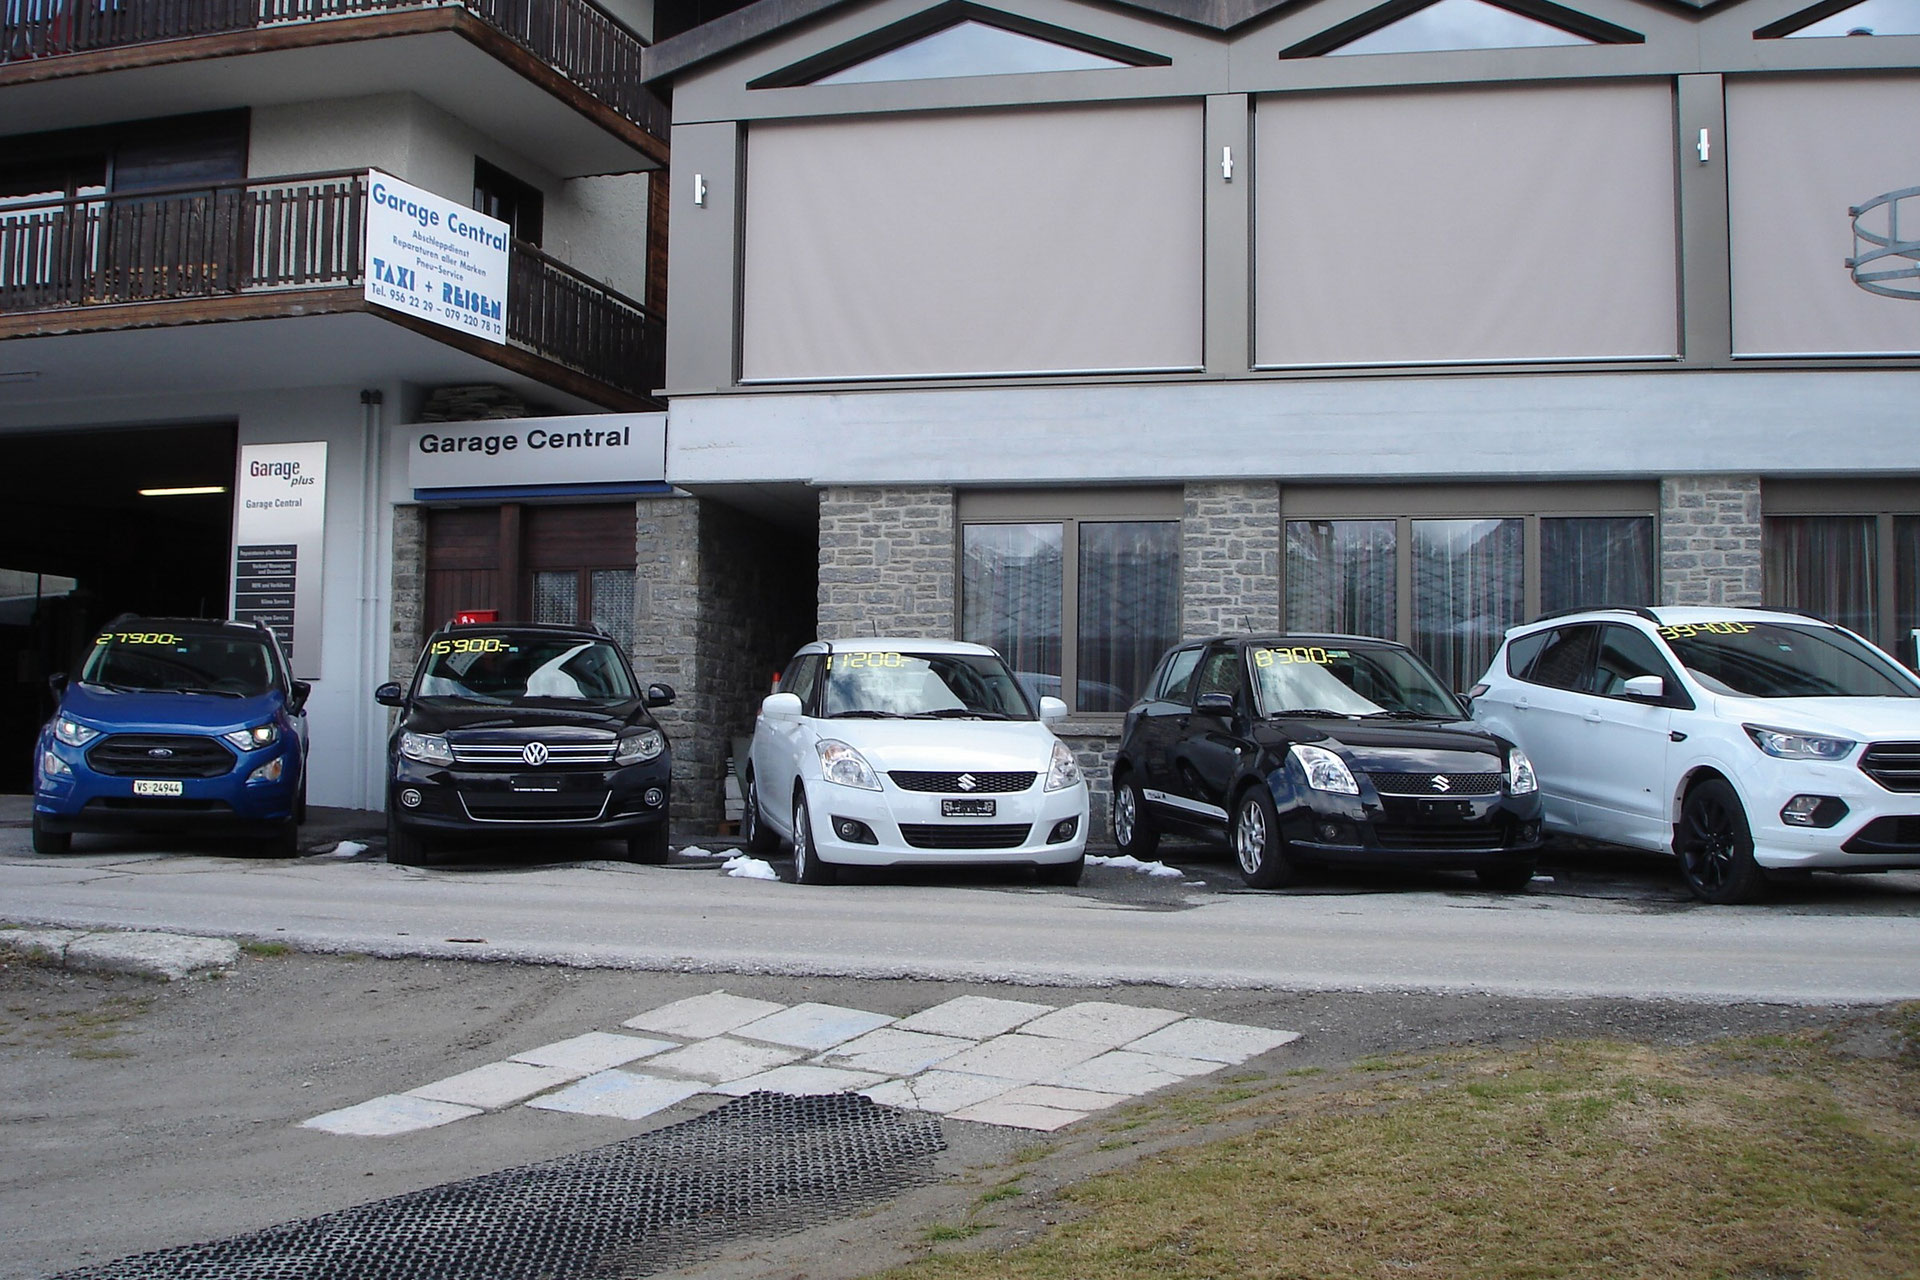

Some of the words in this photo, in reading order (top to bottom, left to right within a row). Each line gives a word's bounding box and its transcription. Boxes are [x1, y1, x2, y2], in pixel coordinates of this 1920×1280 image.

[373, 183, 440, 227] Garage
[448, 213, 507, 252] Central
[392, 235, 439, 260] Reparaturen
[441, 254, 457, 266] aller
[459, 260, 487, 277] Marken
[412, 230, 470, 258] Abschleppdienst
[416, 257, 464, 281] Pneu-Service
[373, 257, 416, 292] TAXI
[442, 281, 502, 321] REISEN
[371, 282, 387, 298] Tel.
[389, 289, 406, 304] 956
[409, 295, 420, 308] 22
[422, 300, 434, 312] 29
[445, 307, 460, 321] 079
[463, 313, 479, 328] 220
[481, 319, 491, 331] 78
[493, 323, 501, 335] 12
[419, 433, 518, 456] Garage
[526, 426, 630, 449] Central
[250, 460, 300, 480] Garage
[290, 475, 315, 487] plus
[245, 499, 273, 510] Garage
[274, 498, 302, 508] Central
[136, 781, 148, 792] VS
[152, 782, 180, 793] 24944
